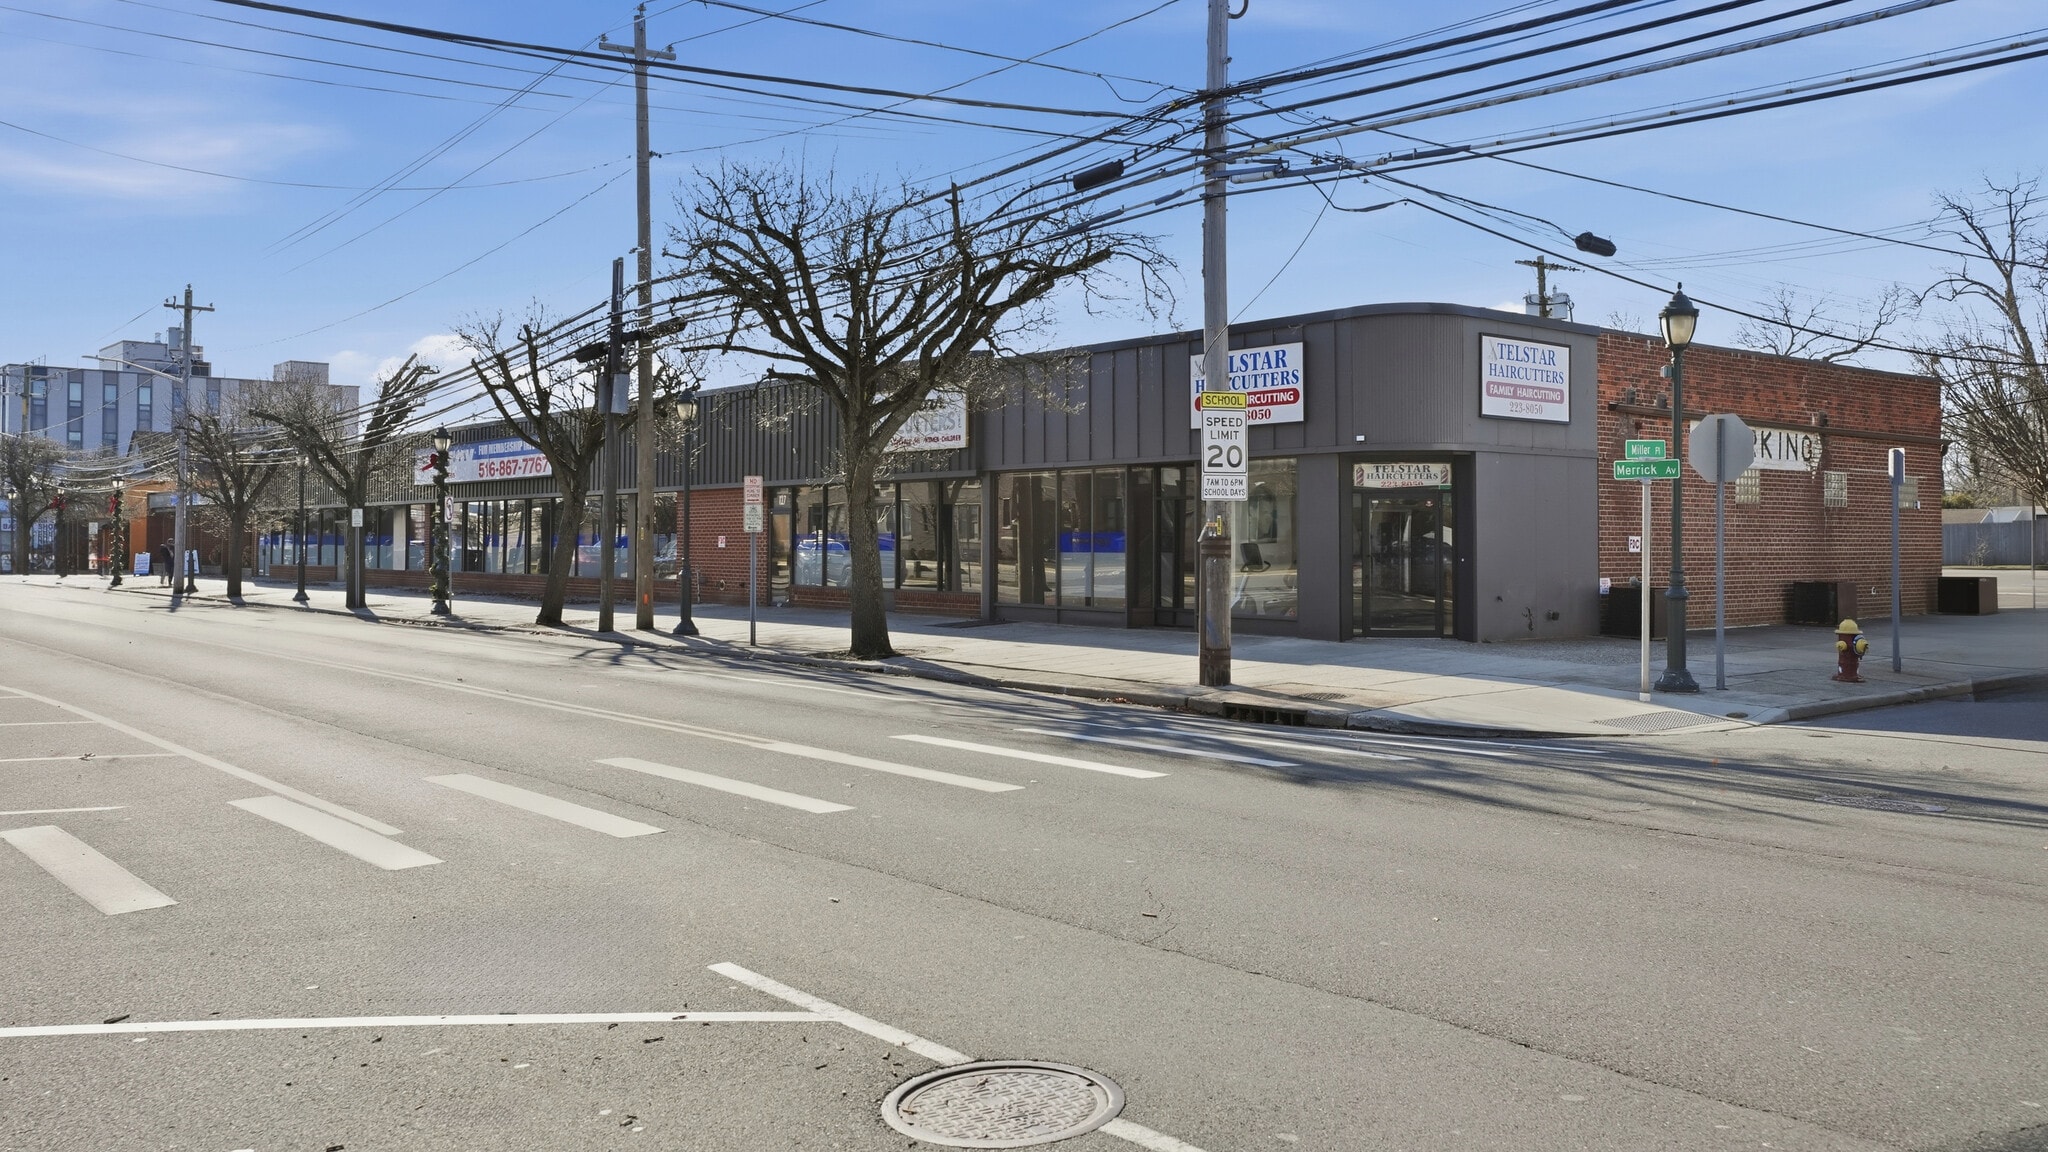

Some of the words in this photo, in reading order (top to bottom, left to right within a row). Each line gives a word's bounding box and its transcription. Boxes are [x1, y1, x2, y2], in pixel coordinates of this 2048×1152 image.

[1497, 342, 1556, 366] TELSTAR
[1228, 349, 1288, 373] LSTAR
[1489, 362, 1564, 384] HAIRCUTTERS
[1195, 369, 1300, 394] HCUTTERS
[1489, 384, 1515, 396] FAMILY
[1517, 387, 1561, 401] HAIRCUTTING
[1205, 395, 1243, 405] SCHOOL
[1509, 401, 1544, 415] 223-8050
[1206, 416, 1243, 427] SPEED
[1210, 430, 1239, 440] LIMIT
[1631, 444, 1651, 455] Miller
[1207, 444, 1243, 468] 20
[1373, 464, 1431, 473] TELSTAR
[1616, 464, 1657, 475] Merrick
[1665, 466, 1676, 474] Av
[1367, 472, 1438, 480] HAIRCUTTERS
[1206, 478, 1220, 486] 7AM
[1221, 478, 1229, 486] TO
[1230, 478, 1244, 486] 6PM
[1204, 488, 1229, 496] SCHOOL
[1230, 488, 1246, 496] DAYS
